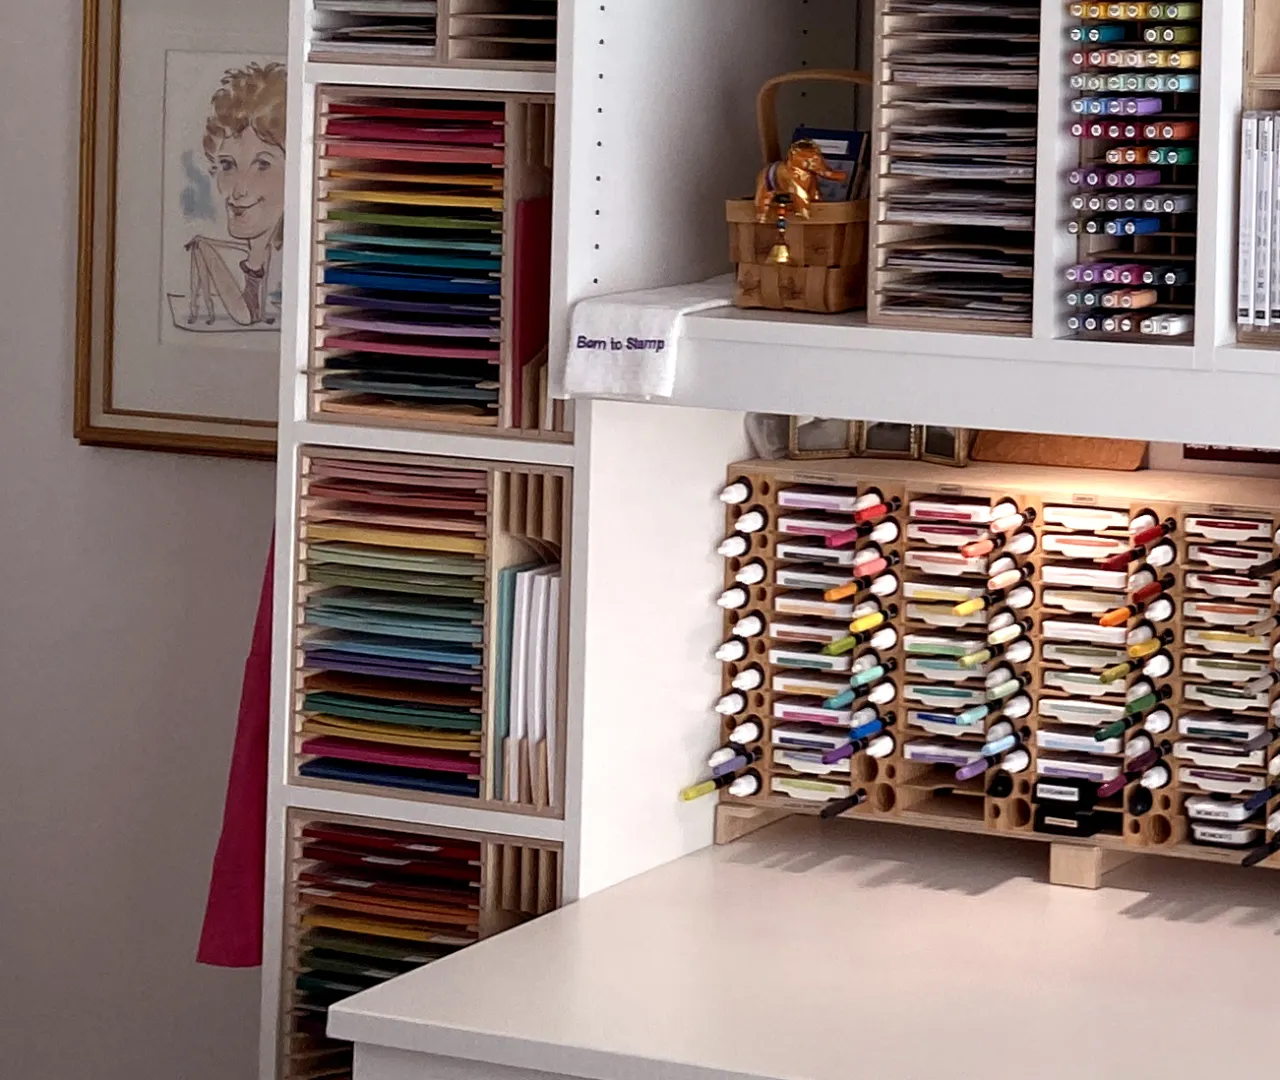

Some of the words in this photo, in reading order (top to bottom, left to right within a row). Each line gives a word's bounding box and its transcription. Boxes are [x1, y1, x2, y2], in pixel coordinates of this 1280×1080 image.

[577, 335, 606, 350] Born
[611, 337, 622, 350] to
[626, 337, 665, 353] Stamp
